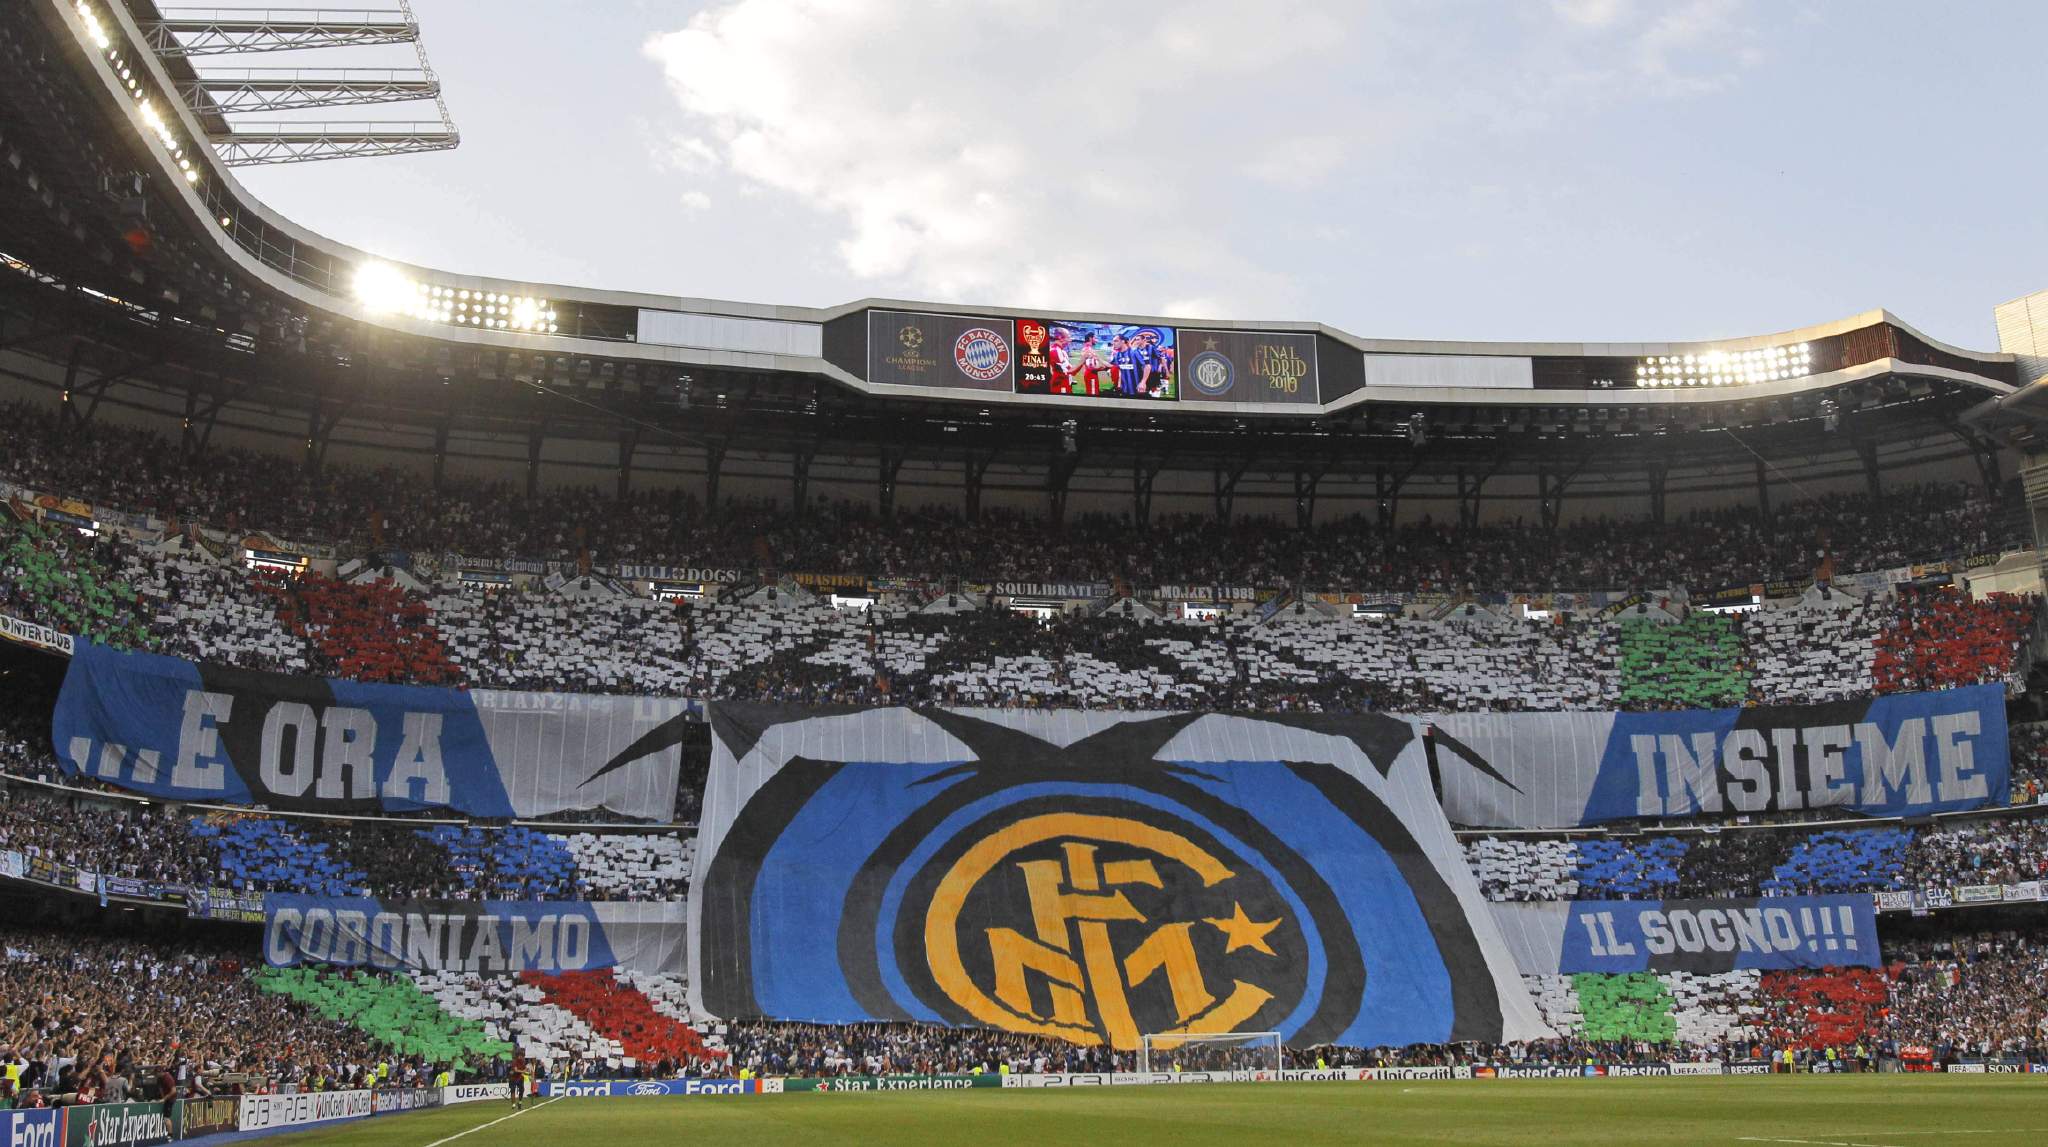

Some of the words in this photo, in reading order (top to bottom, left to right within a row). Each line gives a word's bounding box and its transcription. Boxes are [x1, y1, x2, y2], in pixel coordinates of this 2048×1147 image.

[957, 338, 970, 352] FC
[969, 331, 1007, 353] BAYERN
[1022, 355, 1046, 364] FINAL
[1256, 345, 1299, 360] FINAL
[886, 355, 937, 367] CHAMPIONS
[1249, 359, 1307, 378] MADRID
[1269, 375, 1297, 393] 2010
[621, 564, 672, 580] BULL
[687, 566, 736, 584] DOGS
[995, 582, 1091, 598] SQUILIBRATI
[10, 618, 42, 642] INTER
[44, 629, 71, 650] CLUB
[259, 700, 452, 805] ORA
[1630, 711, 1989, 815] INSIEME
[1580, 911, 1632, 957] IL
[1641, 905, 1859, 956] SOGNO!!!
[269, 907, 591, 974] CORONIAMO
[1377, 1066, 1450, 1081] UniCredit
[1497, 1065, 1581, 1079] MasterCard
[1607, 1063, 1669, 1077] Maestro
[1730, 1064, 1770, 1075] RESPECT
[1988, 1064, 2020, 1074] SONY
[2032, 1063, 2048, 1074] Fo
[550, 1081, 611, 1097] Ford
[635, 1085, 661, 1096] Ford
[685, 1080, 744, 1096] Ford
[834, 1077, 871, 1092] Star
[876, 1076, 974, 1090] Experience
[247, 1098, 270, 1126] PS3
[285, 1096, 308, 1123] PS3
[11, 1109, 57, 1147] Ford
[98, 1108, 121, 1146] Star
[121, 1110, 169, 1147] Experienc
